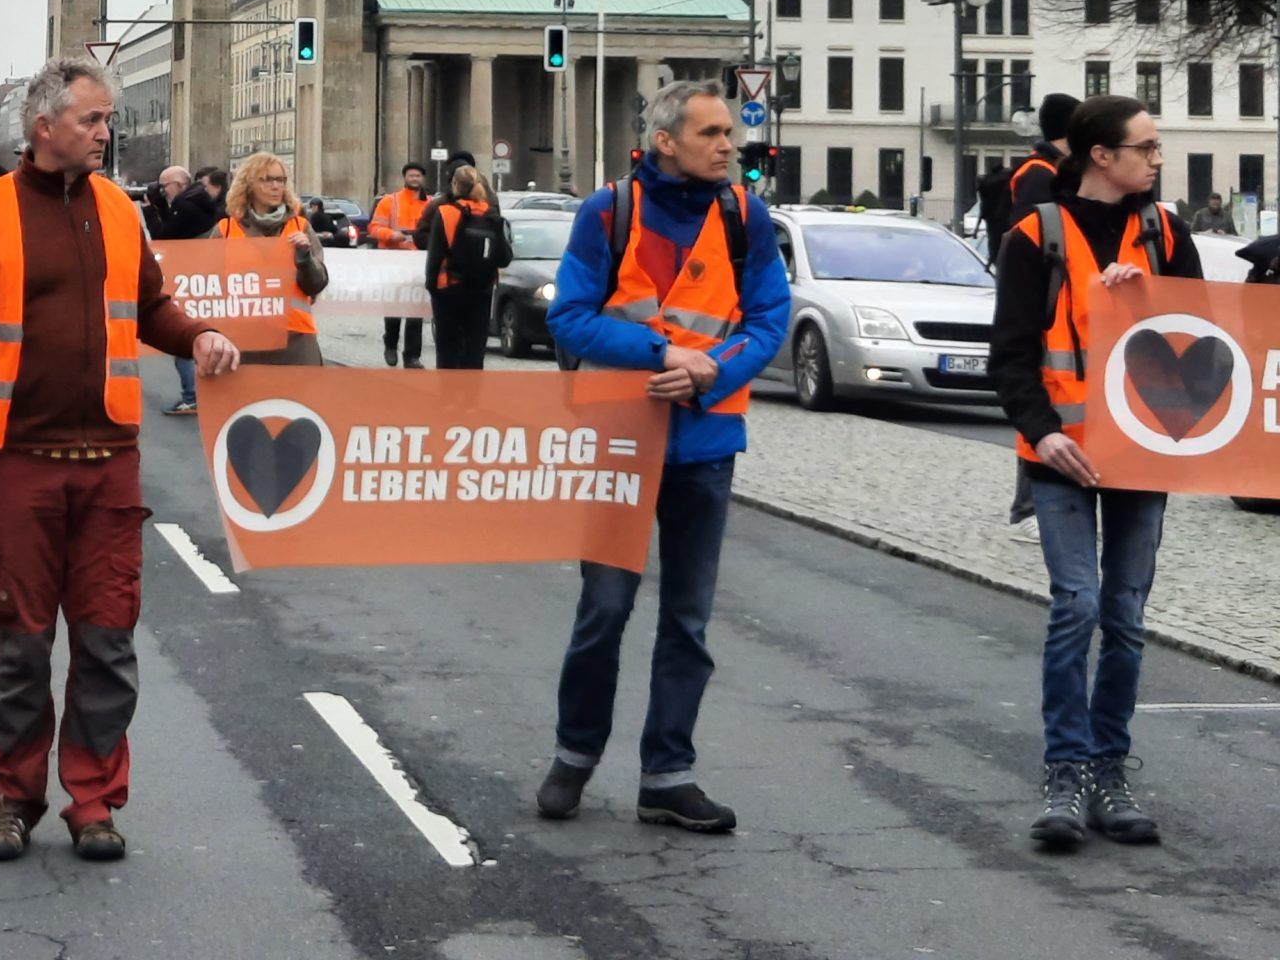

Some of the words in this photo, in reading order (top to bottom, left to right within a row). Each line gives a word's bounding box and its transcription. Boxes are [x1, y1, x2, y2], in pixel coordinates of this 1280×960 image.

[174, 273, 223, 298] 20A
[227, 272, 261, 296] GG
[184, 293, 284, 319] SCHÜTZEN
[343, 426, 433, 464] ART.
[443, 426, 527, 464] 20A
[538, 427, 598, 465] GG
[608, 438, 637, 456] =
[342, 470, 449, 502] LEBEN
[457, 464, 640, 506] SCHÜTZEN
